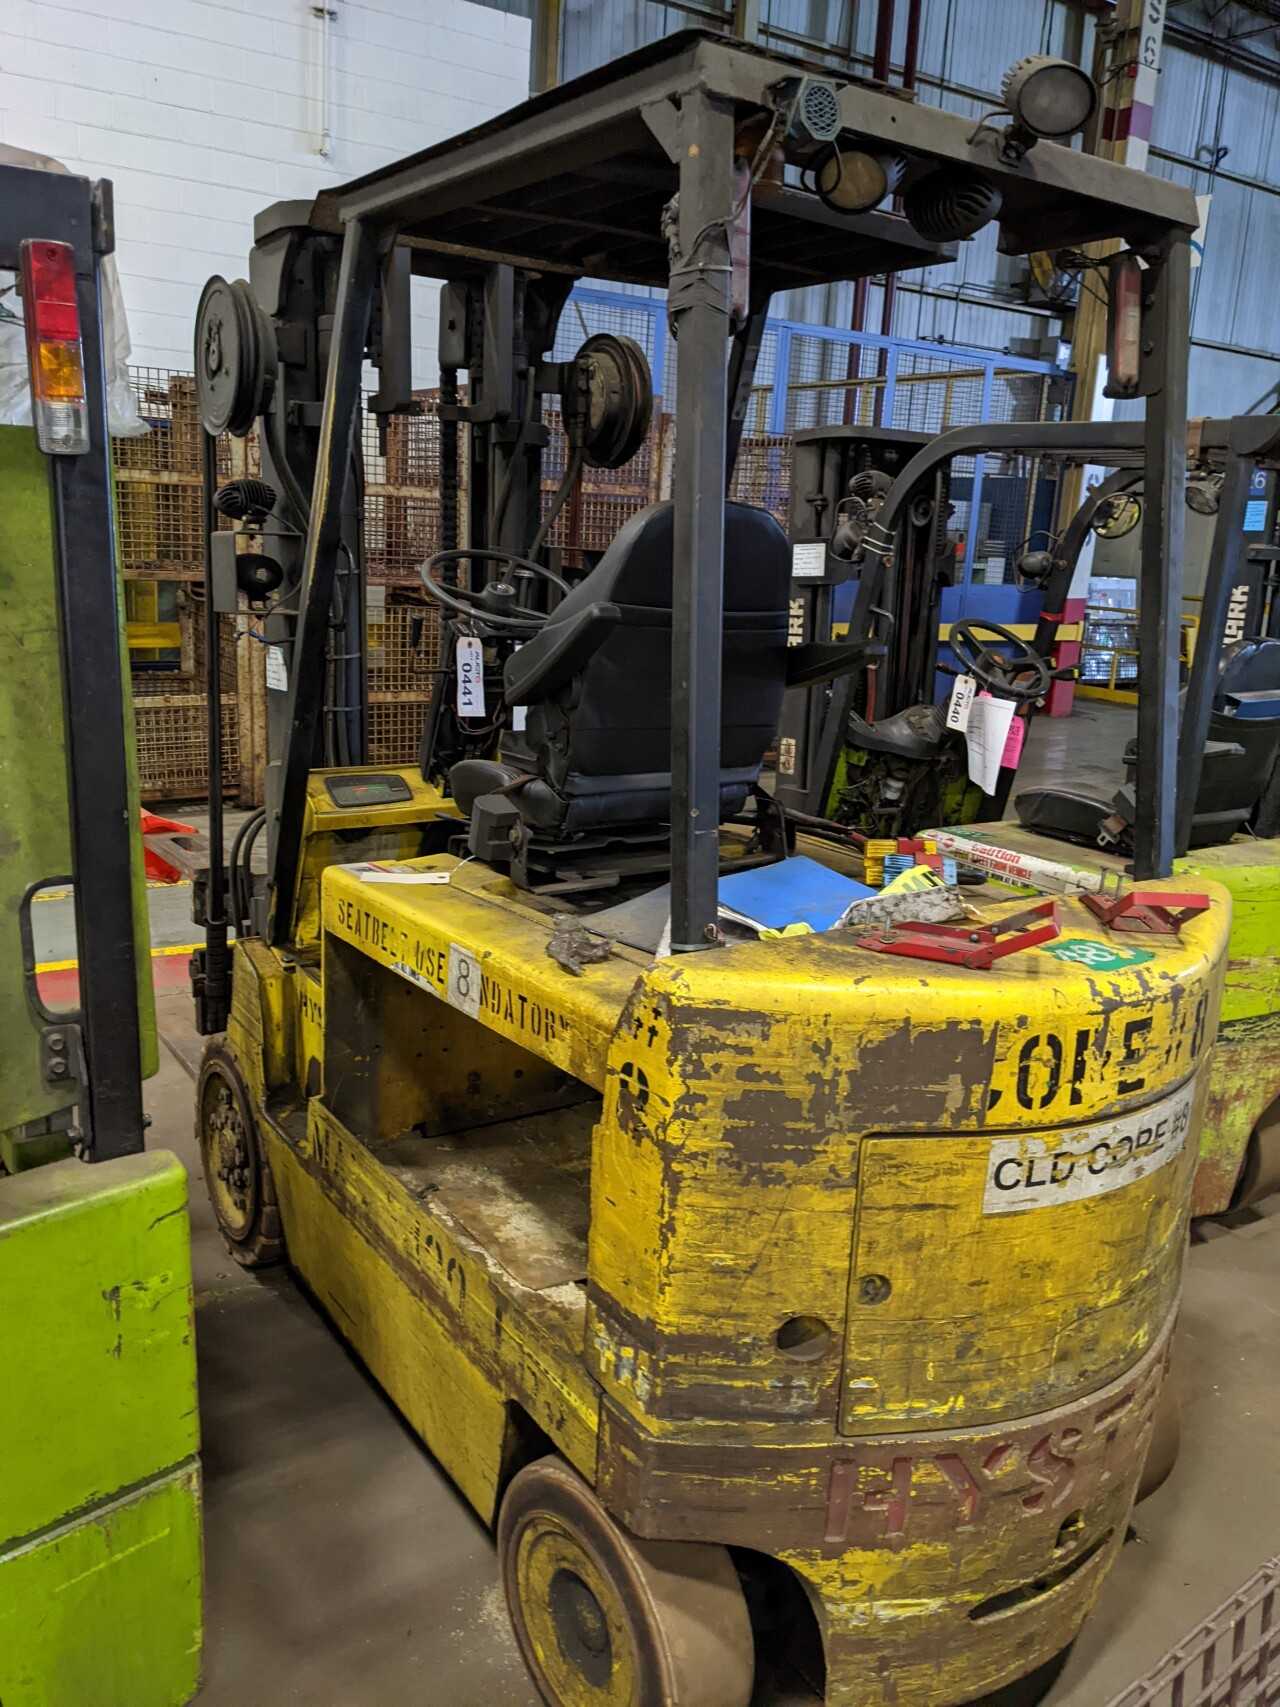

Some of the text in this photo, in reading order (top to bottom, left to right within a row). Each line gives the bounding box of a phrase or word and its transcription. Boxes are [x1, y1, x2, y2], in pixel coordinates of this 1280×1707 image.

[1222, 585, 1249, 648] LARK
[461, 662, 473, 706] 0441
[950, 691, 965, 724] 0440
[457, 957, 470, 998] 8
[993, 1151, 1076, 1191] CLD
